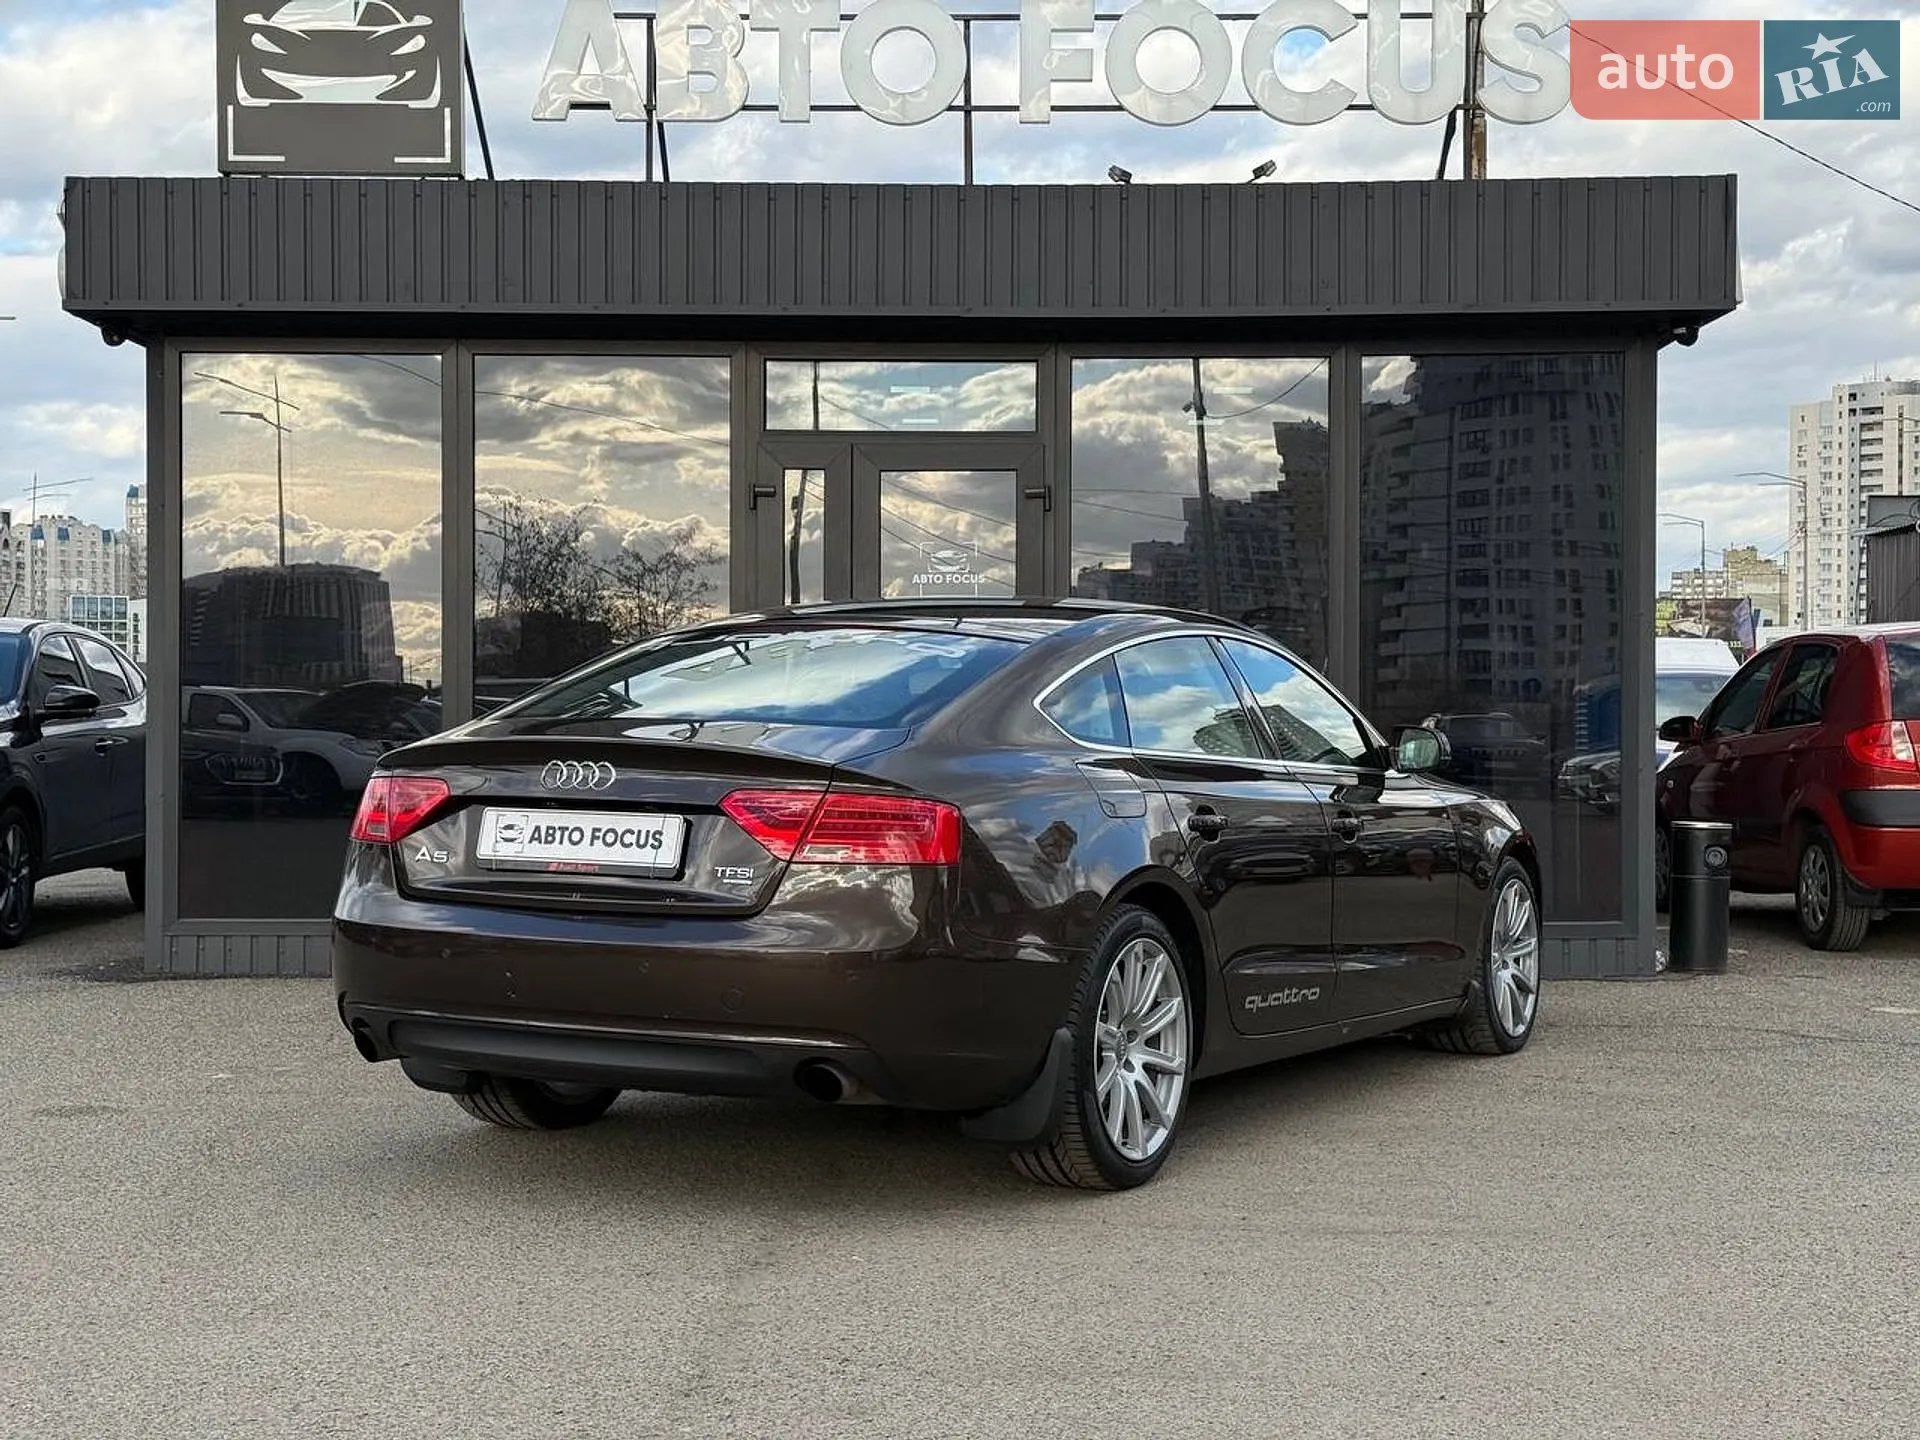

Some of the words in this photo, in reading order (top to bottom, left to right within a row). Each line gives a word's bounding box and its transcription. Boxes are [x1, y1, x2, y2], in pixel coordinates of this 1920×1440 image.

[533, 0, 966, 125] АВТО
[1018, 0, 1572, 126] FOCUS
[911, 574, 943, 584] АВТО
[945, 574, 985, 584] FOCUS
[528, 825, 585, 846] АВТО
[589, 827, 664, 850] FOCUS
[415, 845, 449, 863] A5
[714, 866, 754, 879] TFSI
[1245, 986, 1320, 1013] quattro
